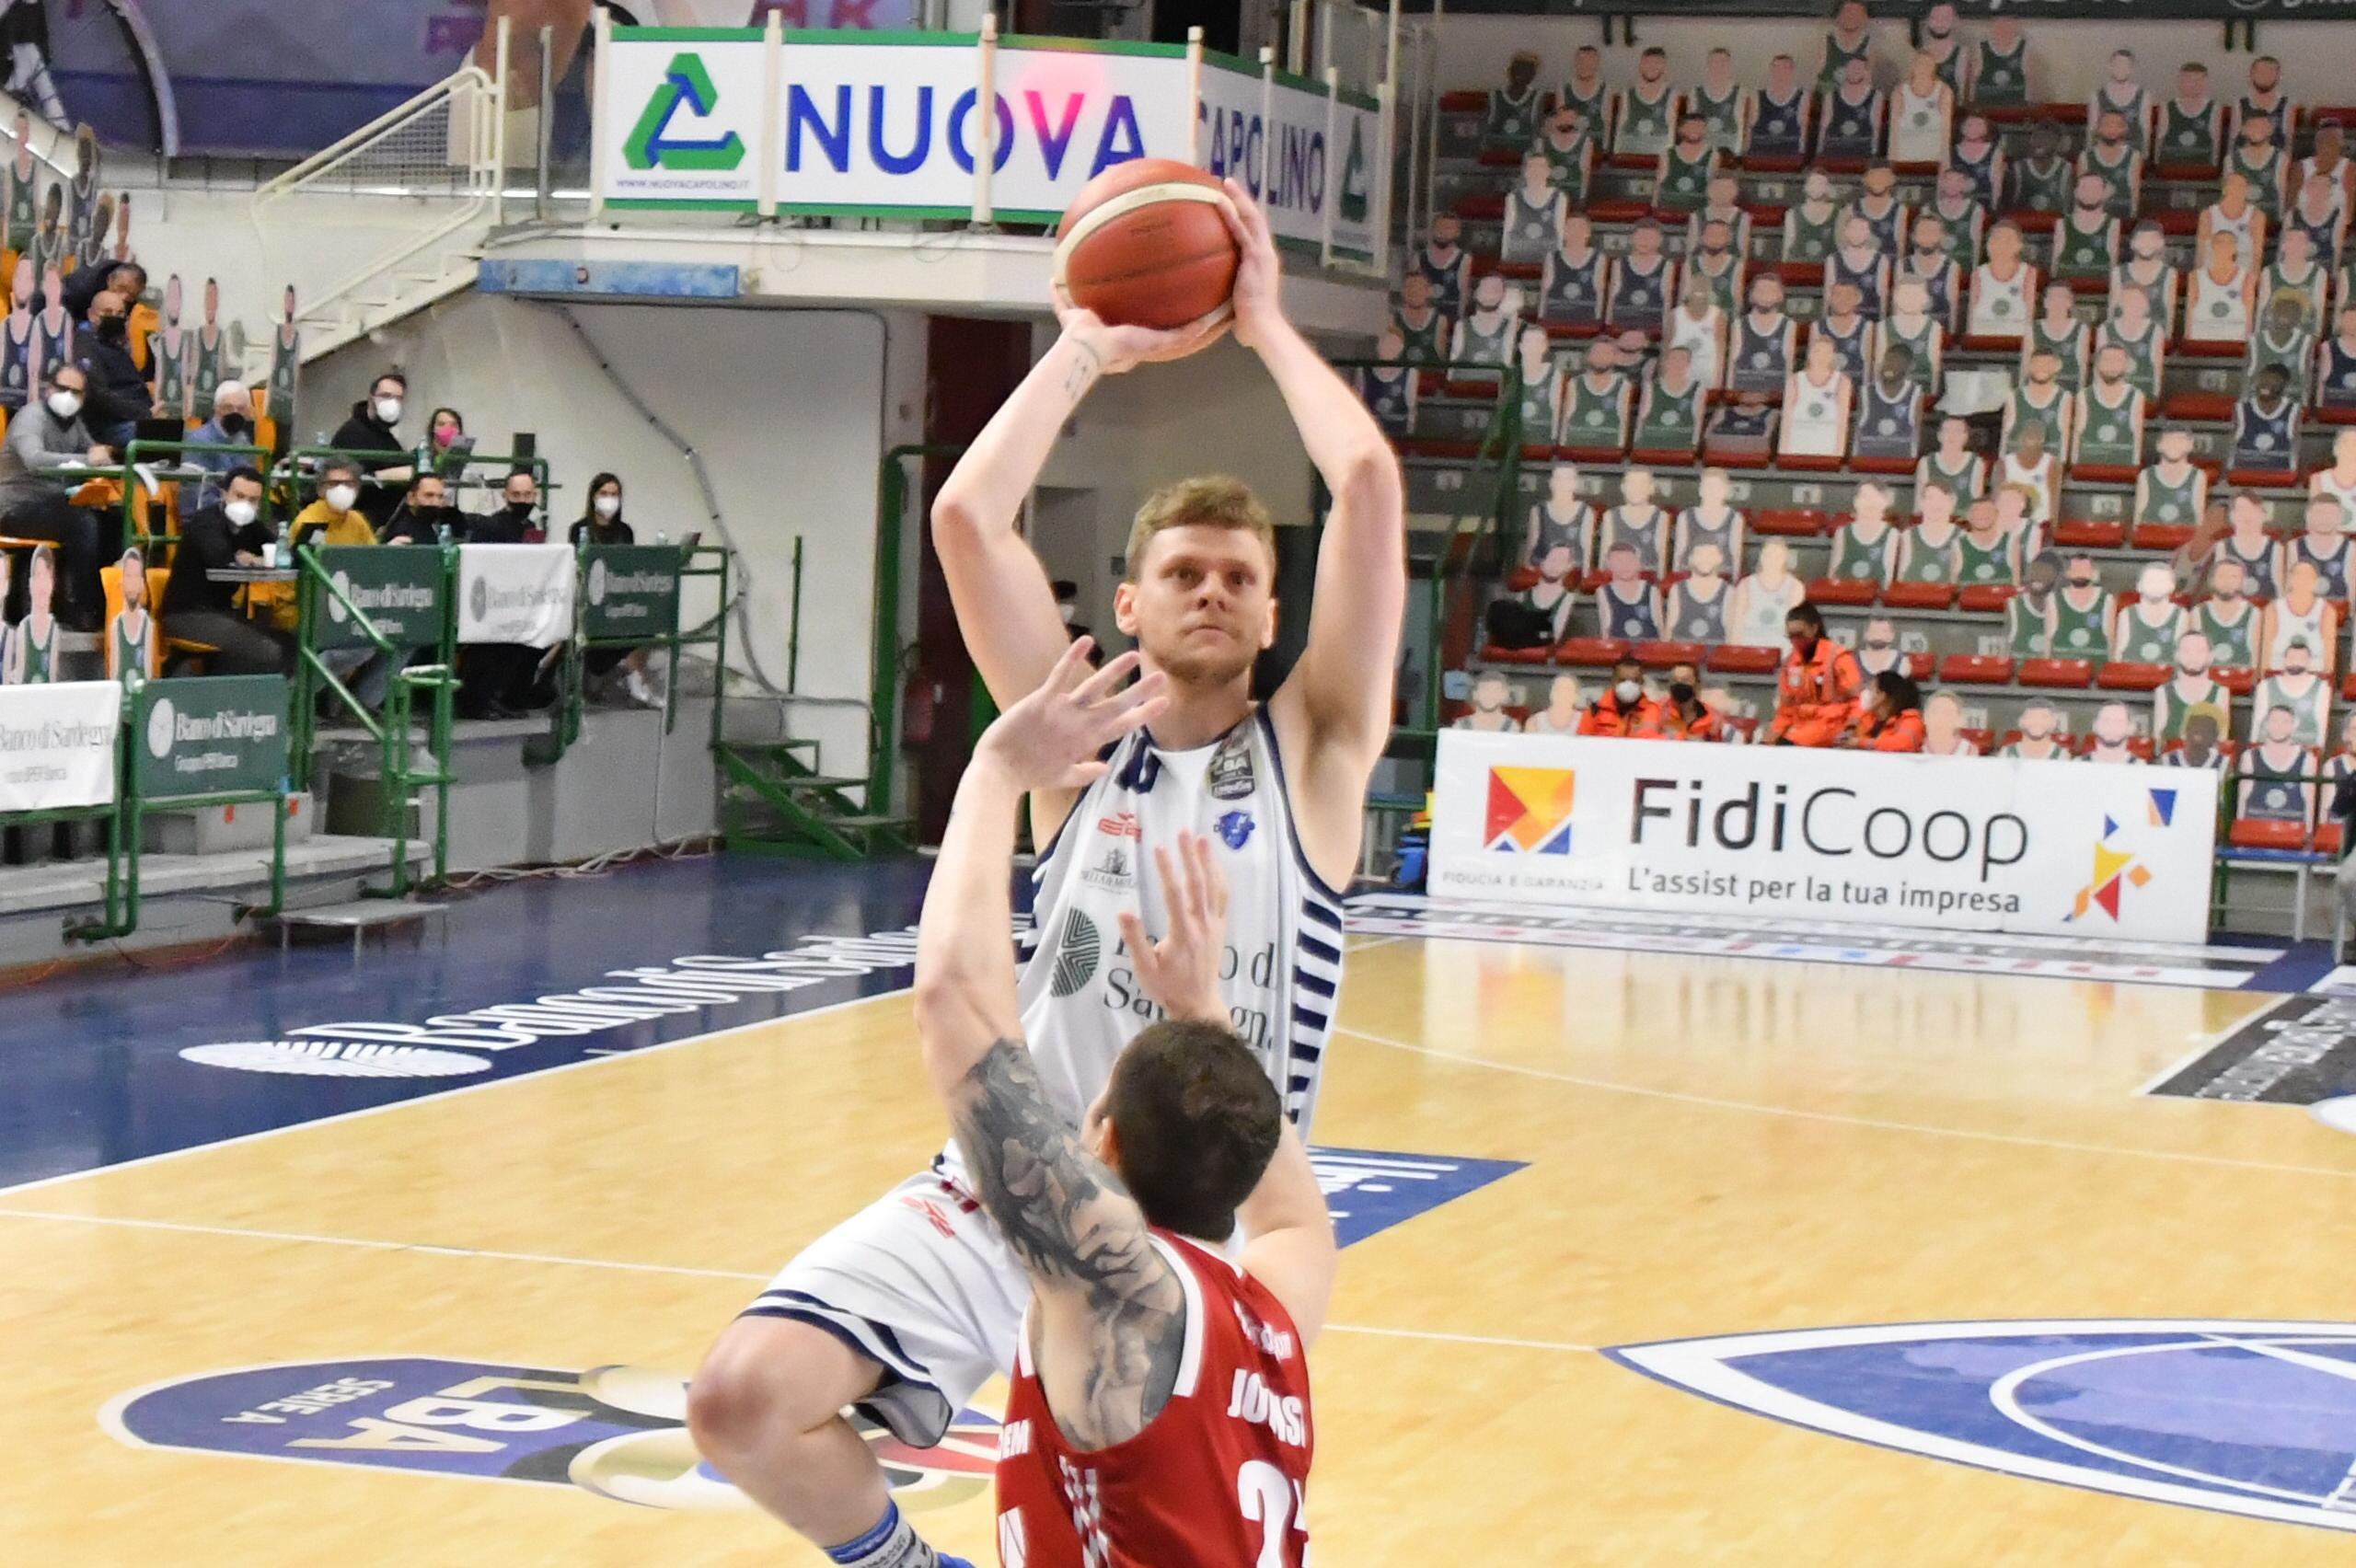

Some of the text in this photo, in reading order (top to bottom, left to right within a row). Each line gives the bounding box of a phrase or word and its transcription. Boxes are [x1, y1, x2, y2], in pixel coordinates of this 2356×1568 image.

[784, 84, 1146, 181] NUOVA
[1630, 778, 2028, 882] FidiCoop
[1628, 867, 2021, 914] L'assist per la tua impresa
